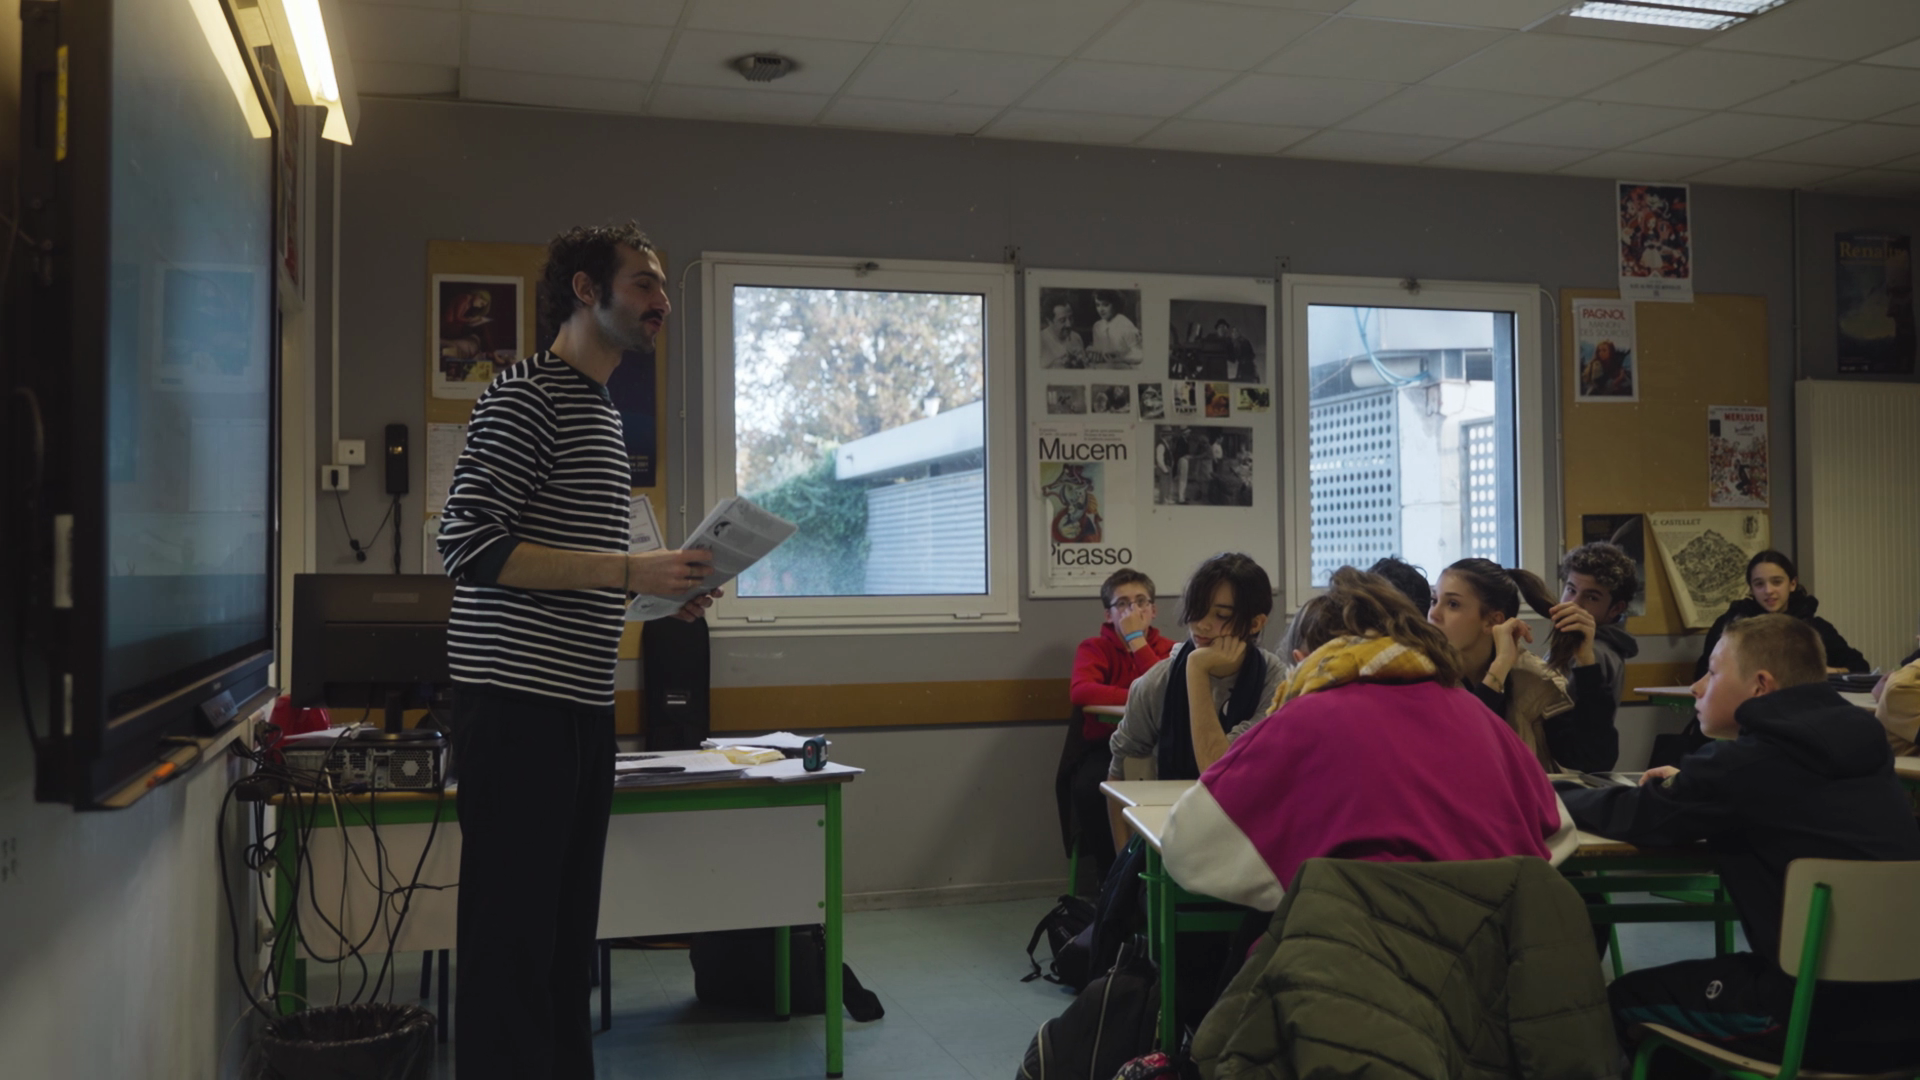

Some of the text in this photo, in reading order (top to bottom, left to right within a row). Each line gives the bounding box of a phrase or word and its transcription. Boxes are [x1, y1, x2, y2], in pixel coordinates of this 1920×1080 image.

[1582, 308, 1625, 320] PAGNOL
[1588, 321, 1621, 329] MANON
[1724, 413, 1764, 422] MERLUSSE
[1039, 437, 1127, 461] Mucem
[1660, 518, 1701, 526] CASTELLET
